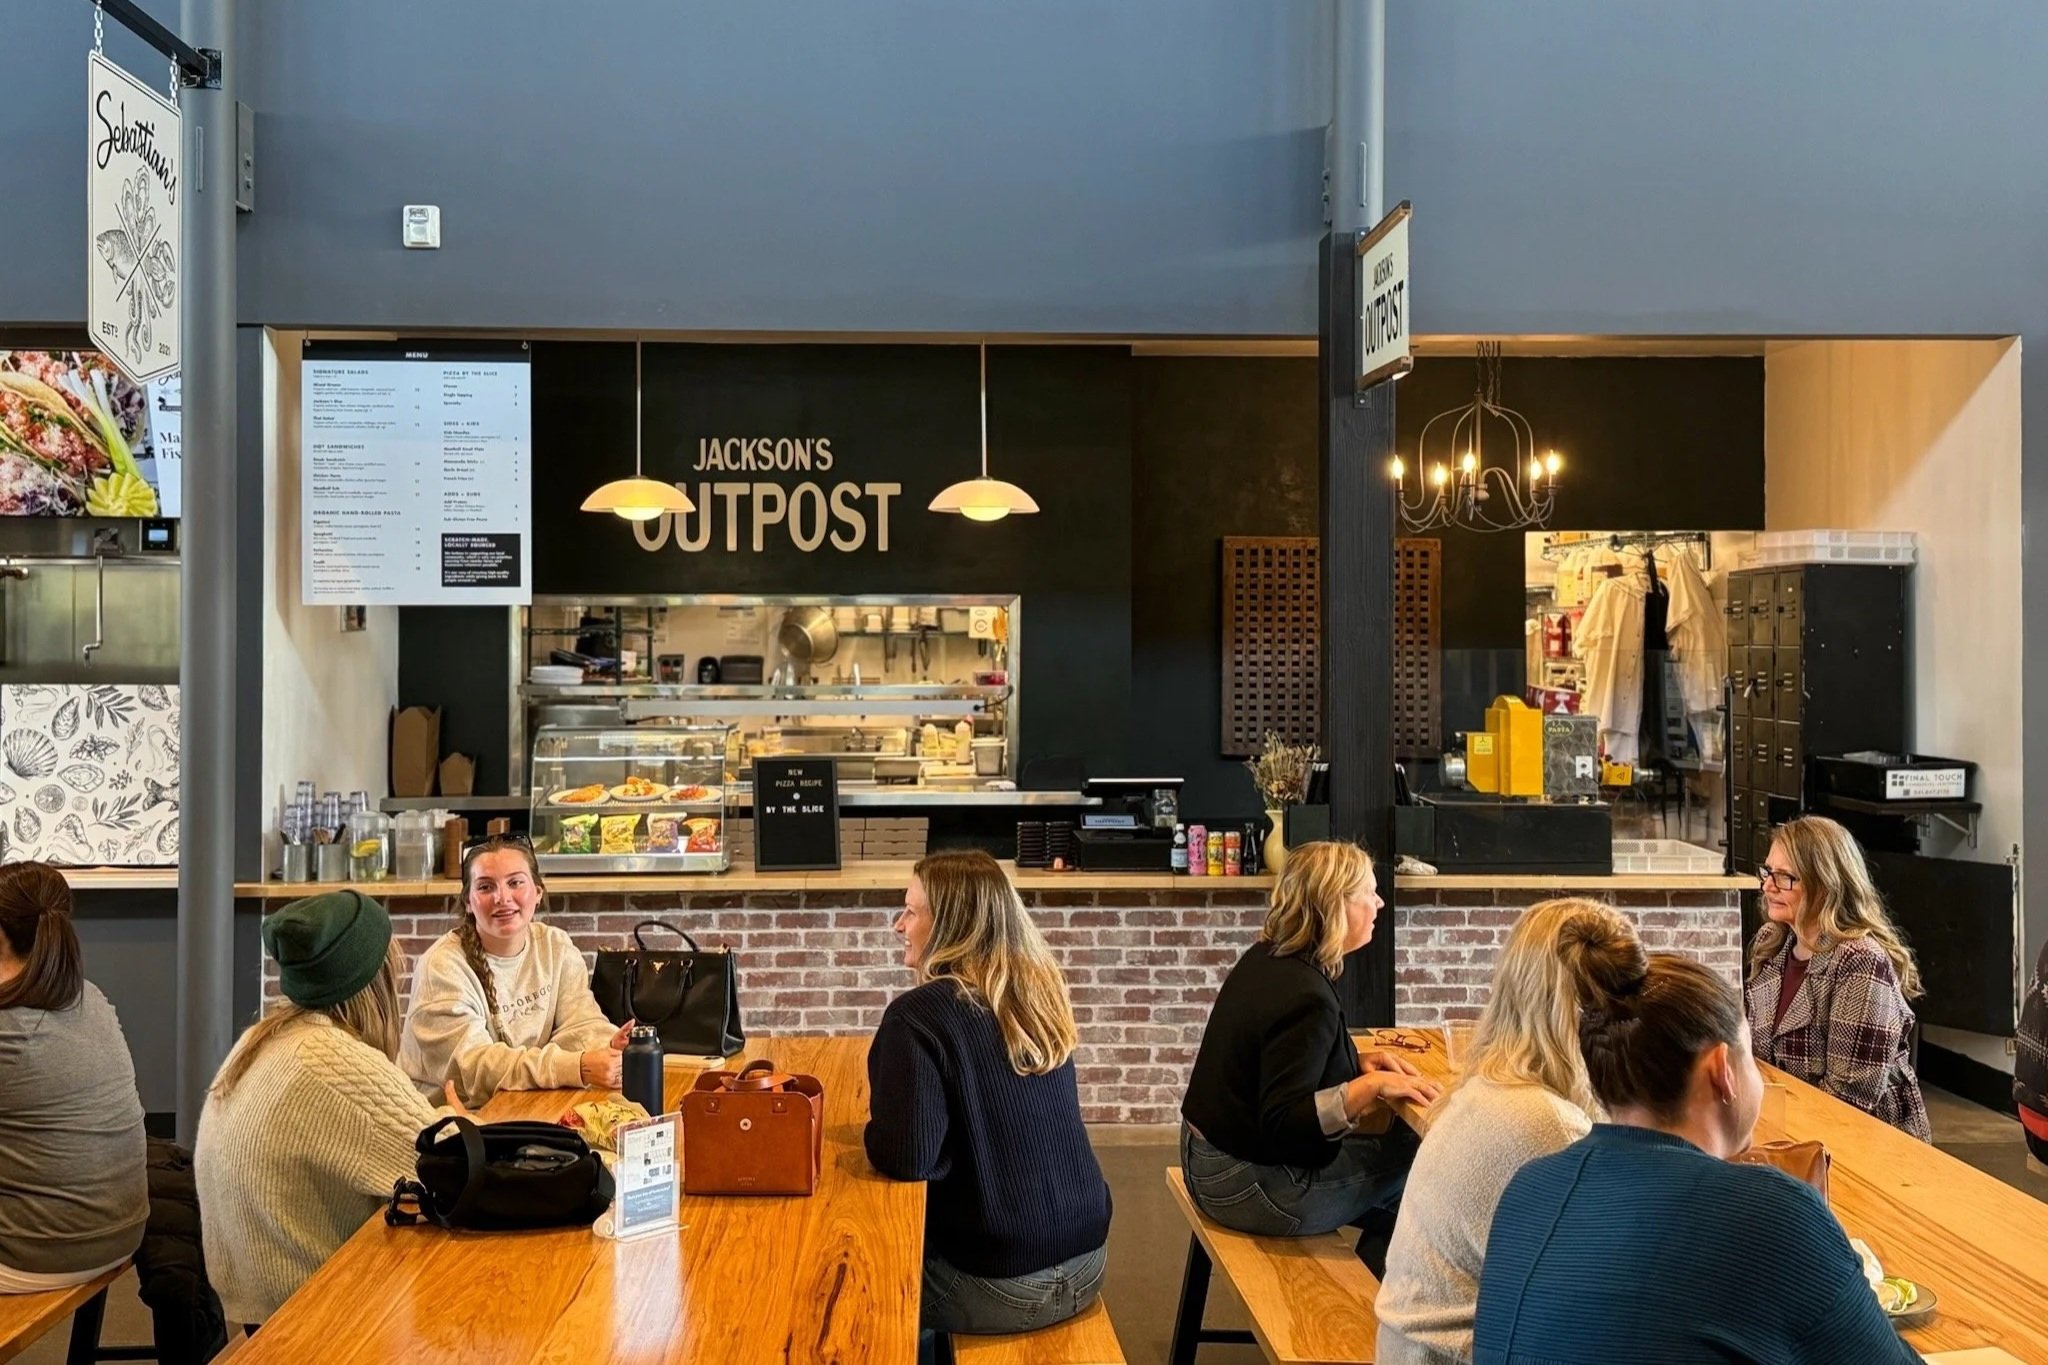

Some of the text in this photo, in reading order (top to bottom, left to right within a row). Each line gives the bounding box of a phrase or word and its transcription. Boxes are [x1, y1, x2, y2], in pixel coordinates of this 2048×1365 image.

[95, 89, 178, 206] Sebastian's
[1373, 252, 1394, 291] JACKSON'S
[1365, 279, 1405, 357] OUTPOST
[159, 342, 171, 356] 2021
[405, 351, 429, 360] MENU
[692, 437, 835, 472] JACKSON'S
[787, 768, 804, 776] NEW
[1905, 773, 1963, 782] FINAL TOUCH
[775, 778, 824, 787] PIZZA RECIPE
[765, 804, 825, 814] BY THE SLICE
